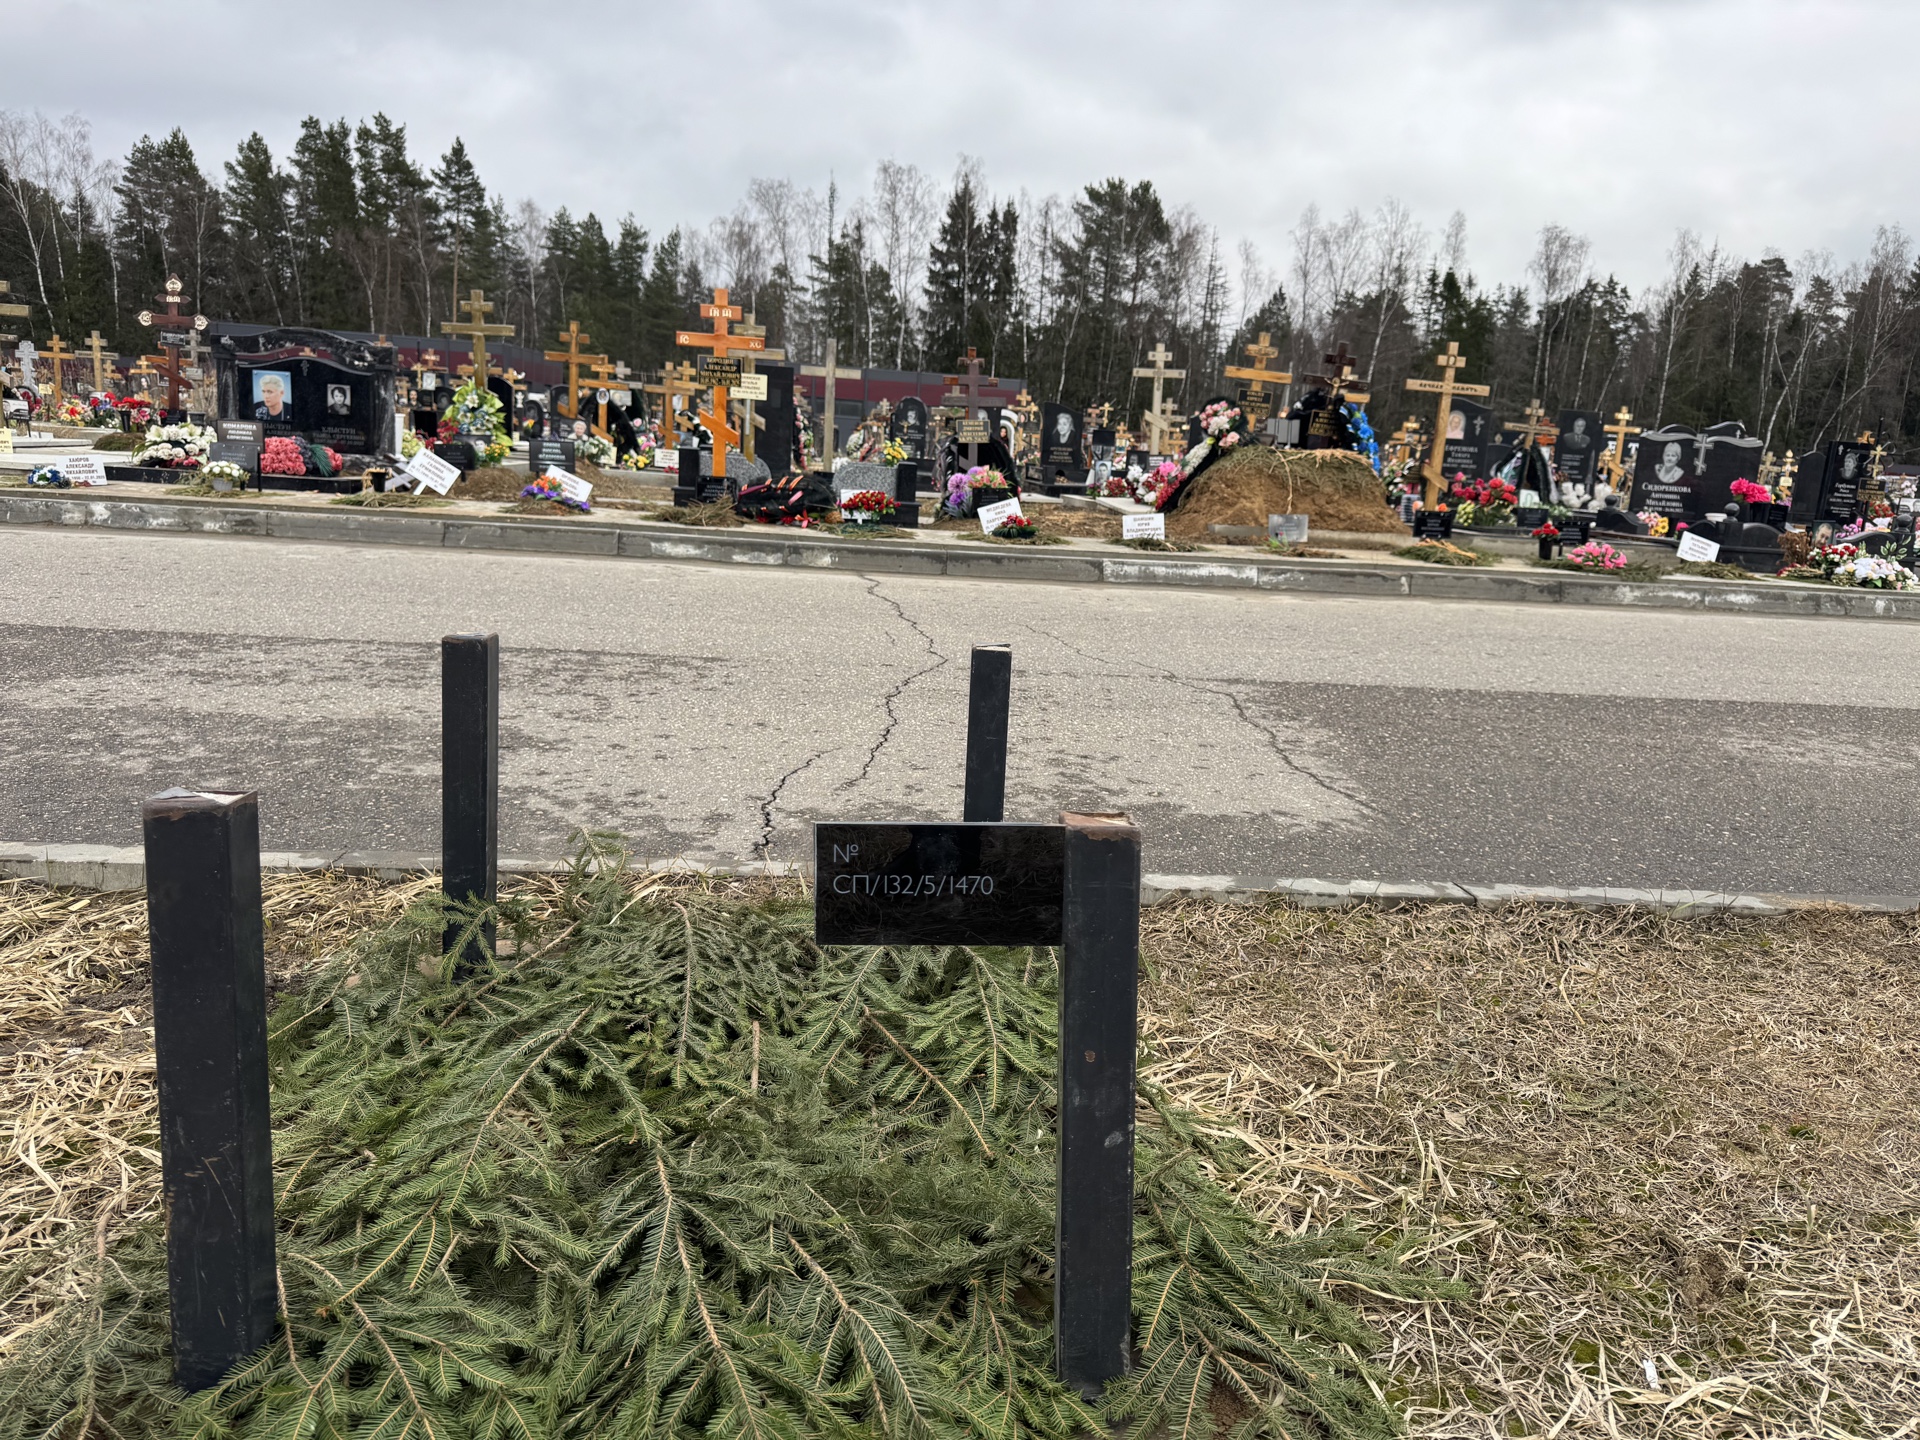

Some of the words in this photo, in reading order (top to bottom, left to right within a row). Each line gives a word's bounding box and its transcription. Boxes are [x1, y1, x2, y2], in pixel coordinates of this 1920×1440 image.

[704, 364, 737, 372] АЛЕКСАНДР
[700, 371, 740, 380] МИХАЙЛОВИЧ
[986, 502, 1012, 513] МЕДВЕДЕВА
[1126, 526, 1162, 534] ВЛАДИМИРОВИЧ
[833, 843, 859, 863] №
[832, 874, 994, 897] СП/132/5/1470
